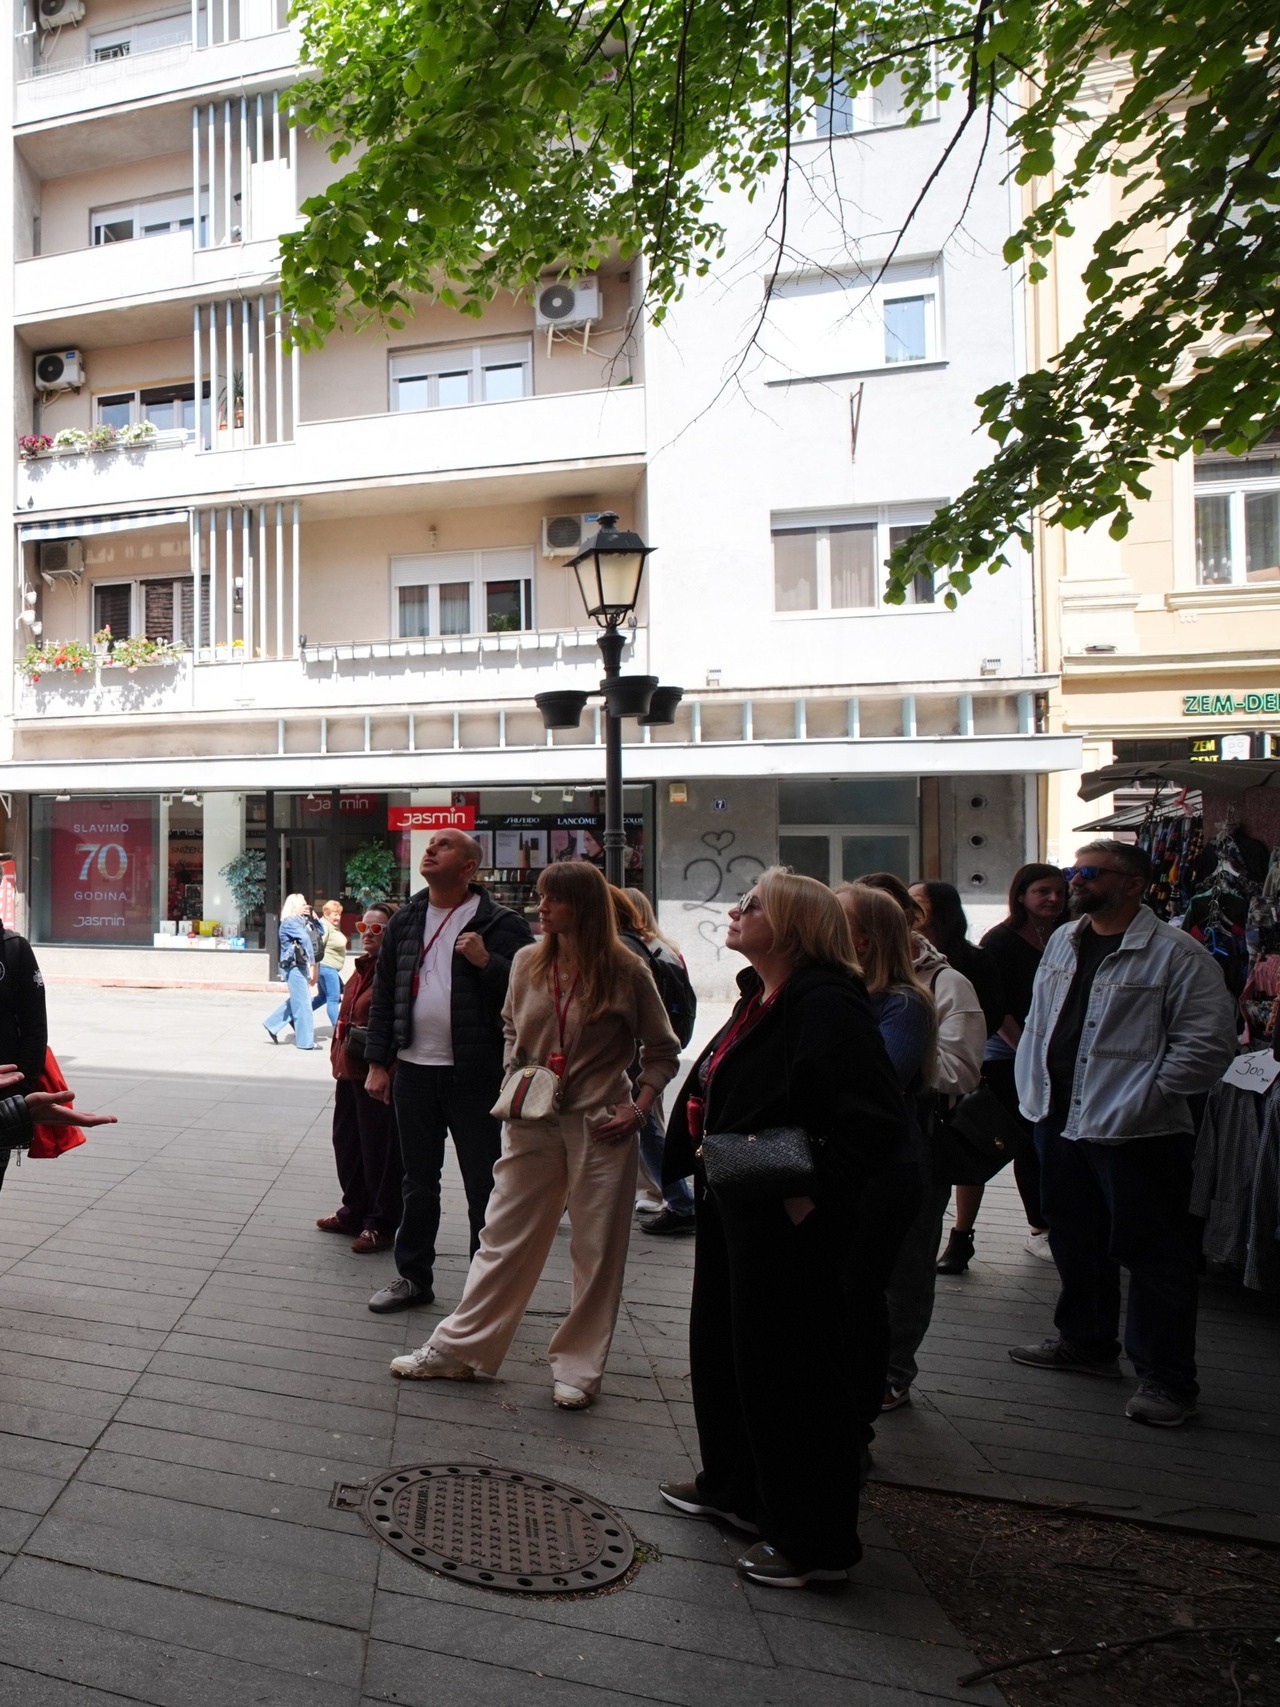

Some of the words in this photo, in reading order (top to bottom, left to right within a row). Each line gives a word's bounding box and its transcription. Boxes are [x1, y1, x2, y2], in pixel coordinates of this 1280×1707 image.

[1192, 739, 1216, 752] ZEM
[309, 794, 369, 812] Jamin
[717, 800, 723, 809] 7
[503, 816, 540, 824] SHISEIDO
[557, 816, 597, 825] LANCÔME
[73, 823, 129, 833] SLAVIMO
[171, 844, 202, 854] SNIŽEN
[74, 843, 128, 880] 70
[73, 891, 128, 901] GODINA
[1235, 1055, 1264, 1077] 300
